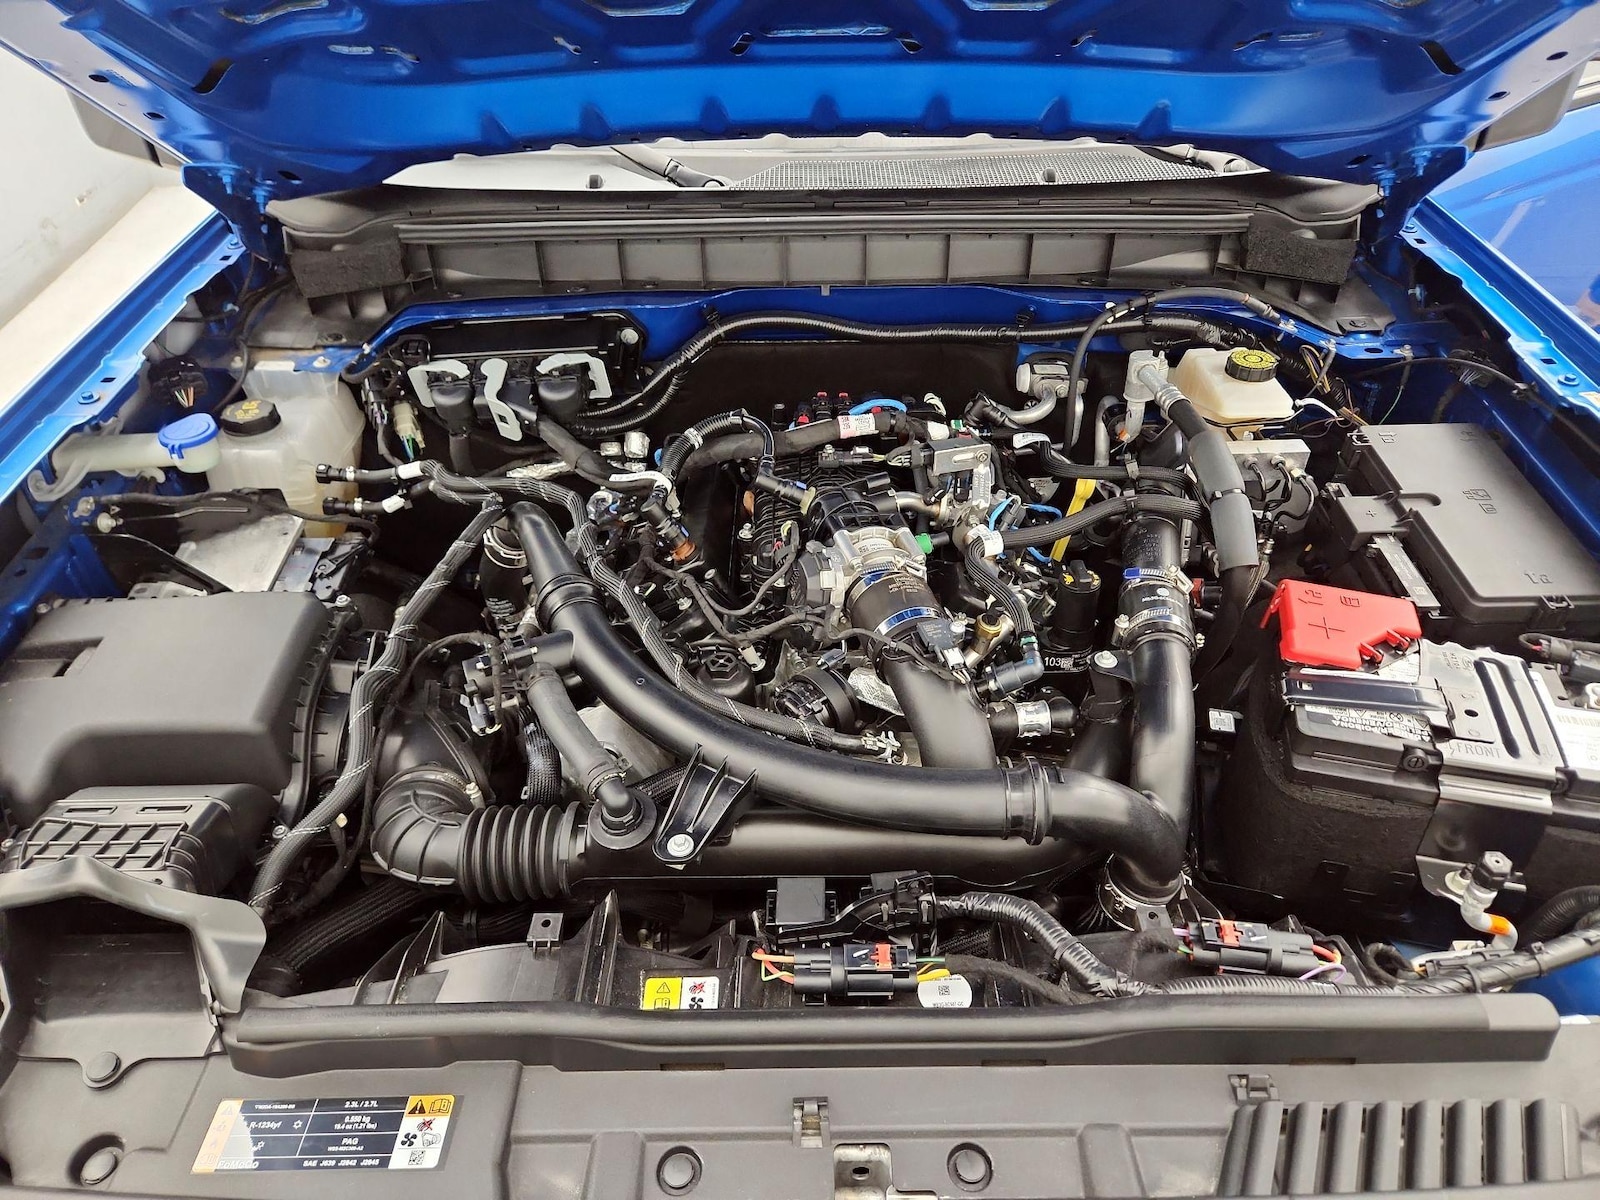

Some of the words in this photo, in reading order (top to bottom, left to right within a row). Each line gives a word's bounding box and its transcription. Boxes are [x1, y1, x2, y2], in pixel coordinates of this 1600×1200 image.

[1045, 656, 1061, 666] 103
[1456, 742, 1500, 758] FRONT
[344, 1100, 360, 1108] 2.3L
[249, 1120, 283, 1130] R-1234yf
[341, 1137, 359, 1145] PAG
[217, 1160, 260, 1169] FoMoCo
[303, 1159, 318, 1167] SAE
